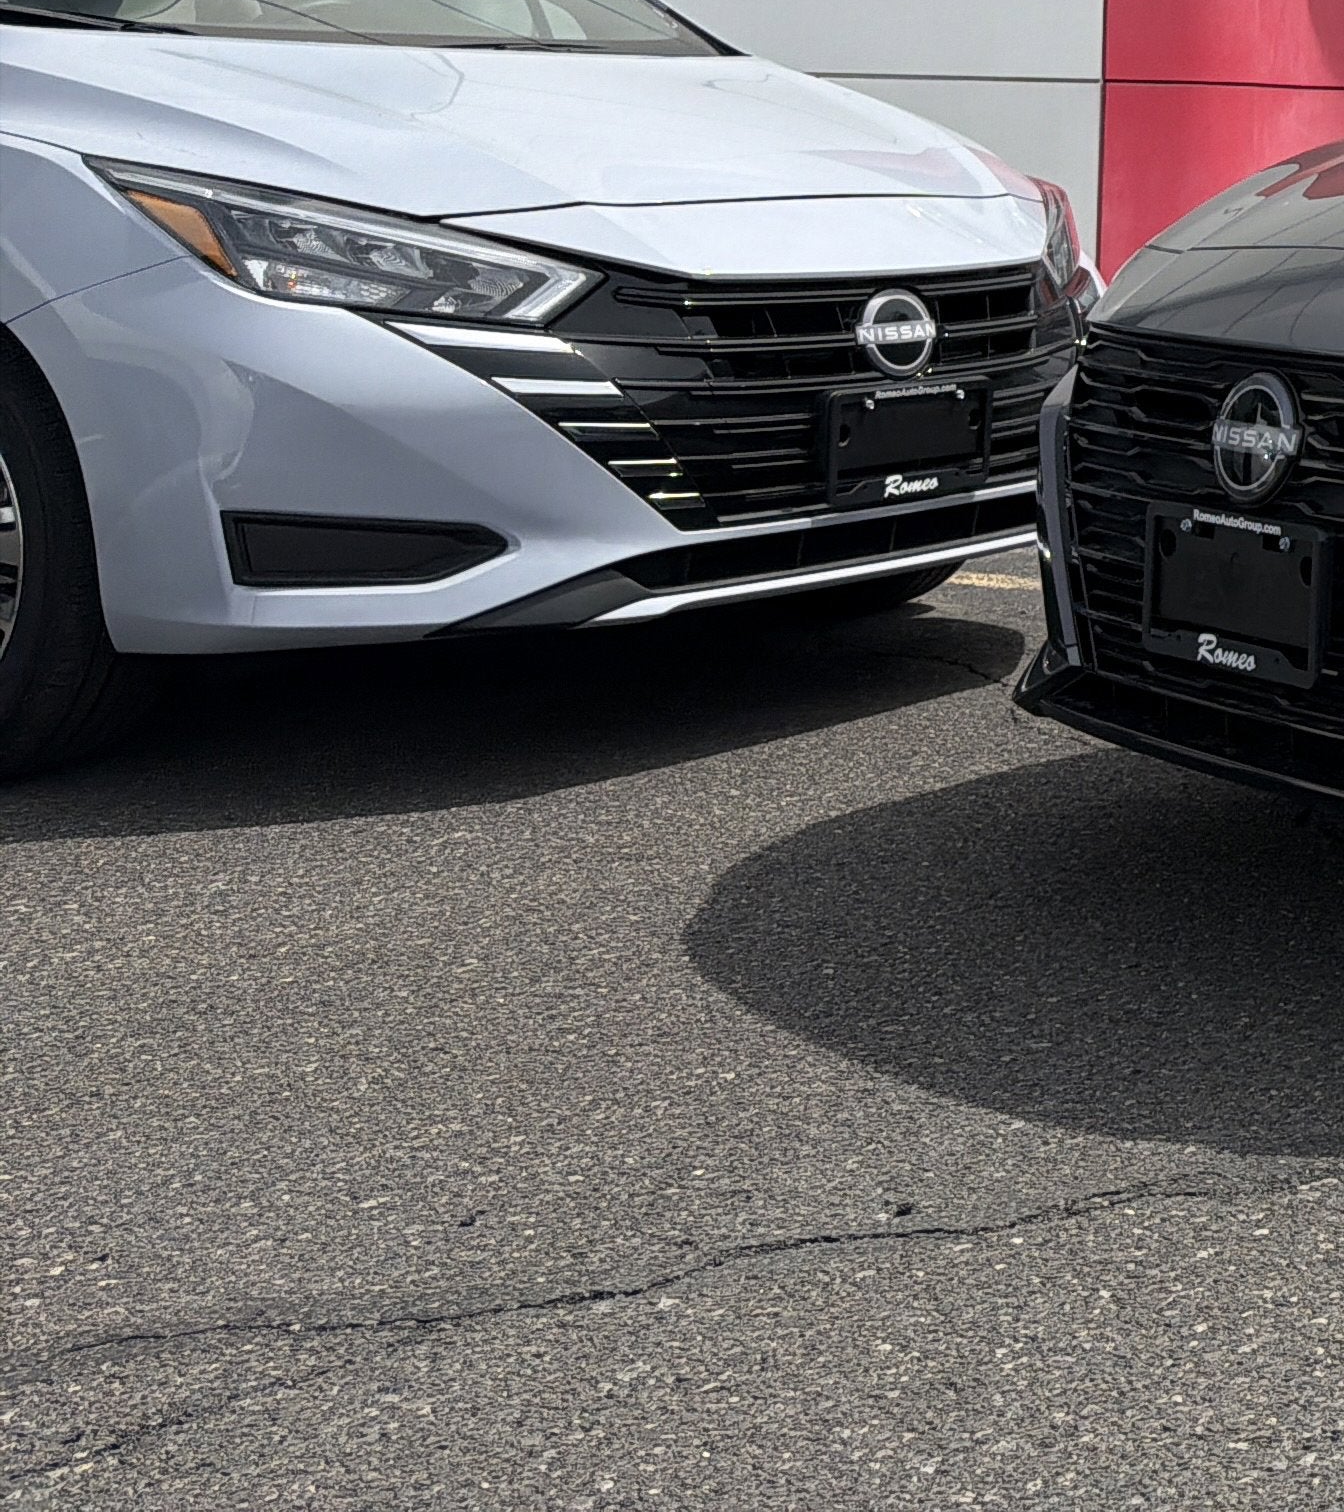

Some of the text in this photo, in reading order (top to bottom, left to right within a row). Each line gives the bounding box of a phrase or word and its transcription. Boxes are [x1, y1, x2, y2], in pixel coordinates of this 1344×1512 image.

[858, 321, 936, 343] NISSAN
[875, 384, 957, 399] RomeoAutoGroup.com
[1212, 421, 1298, 452] NISSAN
[884, 473, 939, 498] Romeo
[1192, 508, 1282, 536] RomeoAutoGroup.com
[1197, 634, 1256, 671] Romeo
